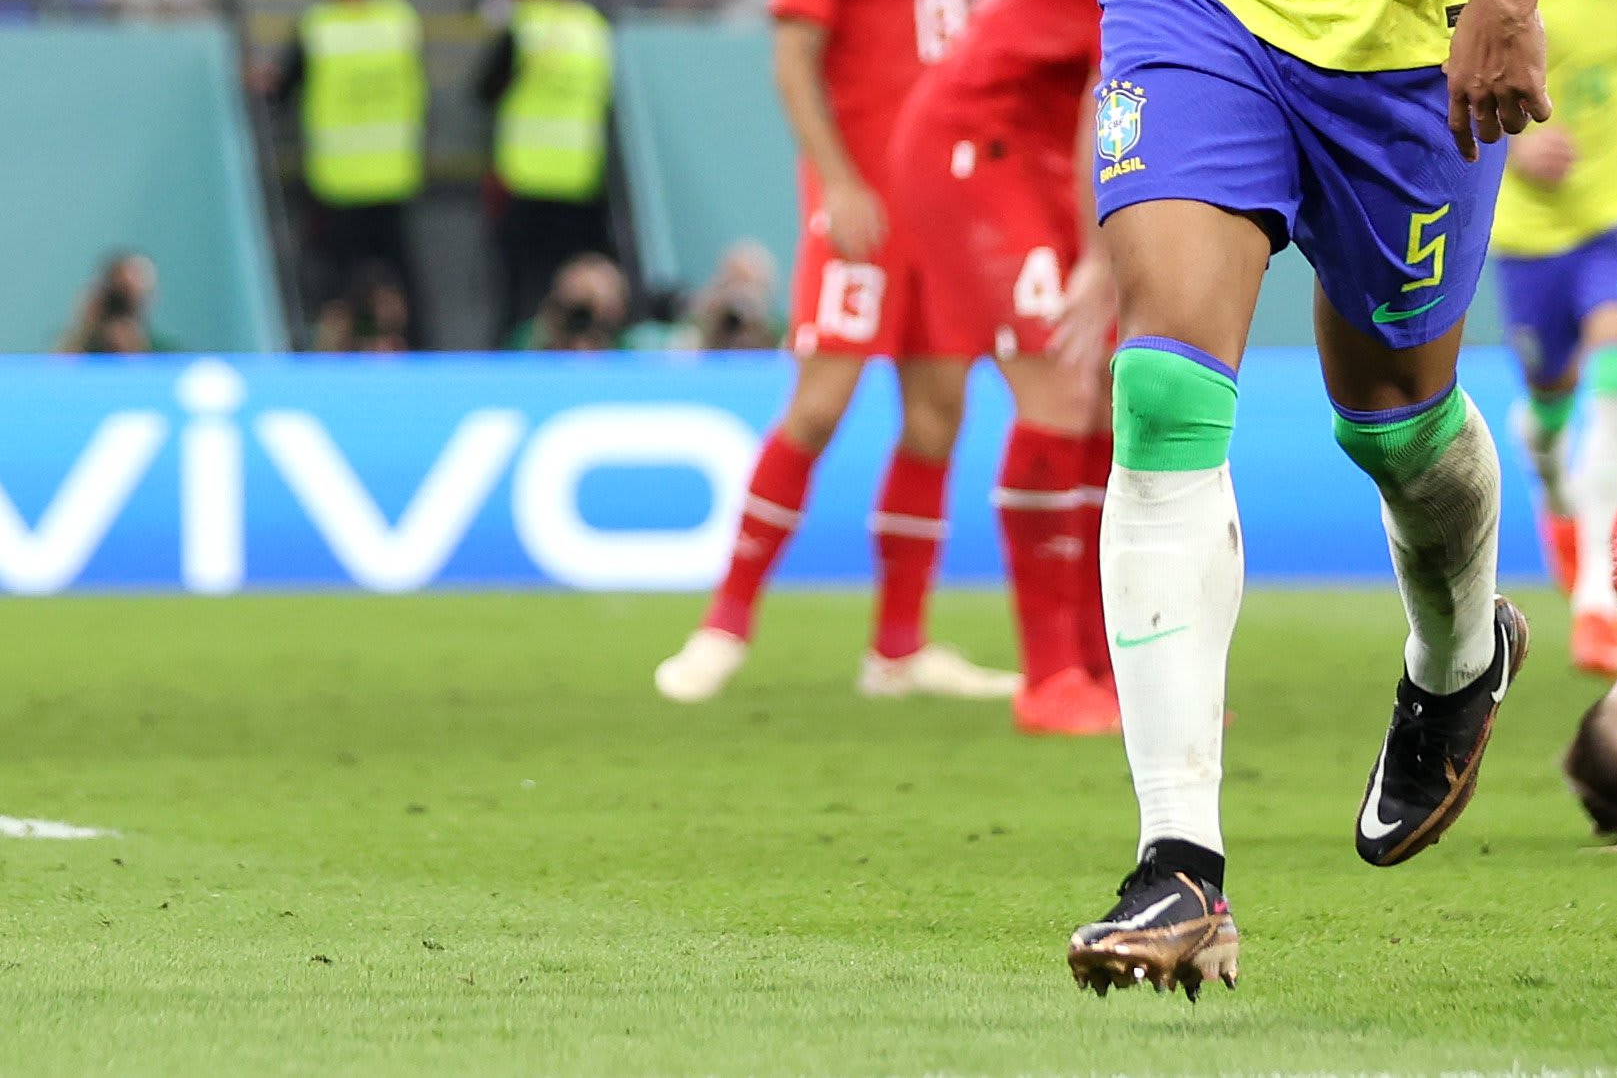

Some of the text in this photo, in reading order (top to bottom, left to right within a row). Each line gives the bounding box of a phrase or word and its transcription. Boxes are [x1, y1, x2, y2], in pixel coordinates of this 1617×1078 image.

[1100, 157, 1146, 183] BRASIL
[1013, 245, 1069, 322] 4
[1401, 202, 1450, 293] 5
[816, 258, 887, 344] 13
